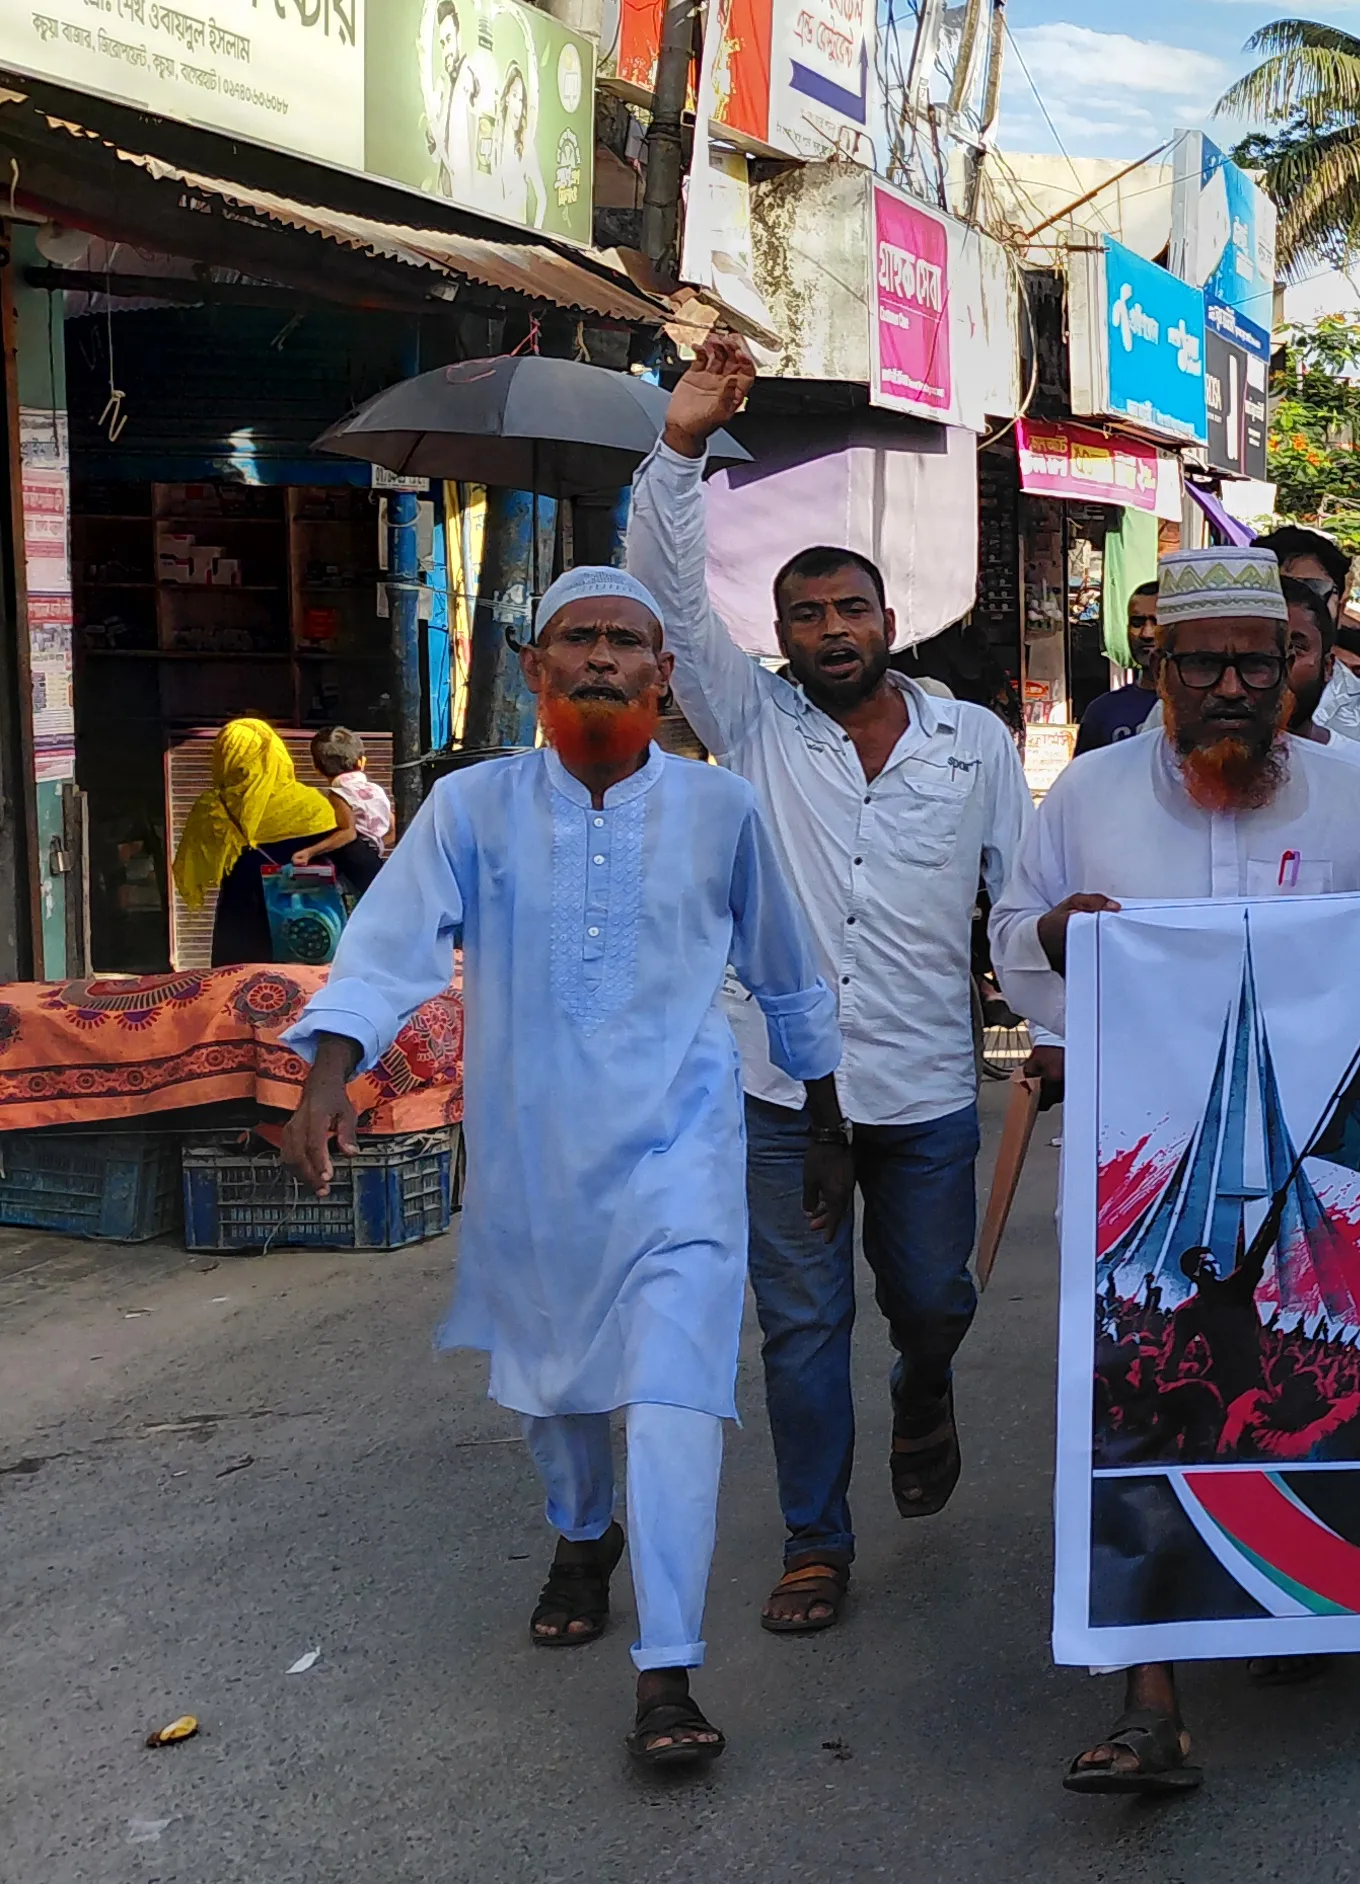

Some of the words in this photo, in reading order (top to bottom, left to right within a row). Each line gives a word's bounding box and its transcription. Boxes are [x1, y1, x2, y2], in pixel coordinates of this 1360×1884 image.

[32, 12, 58, 41] কচুয়া
[62, 22, 95, 53] বাজার,
[152, 53, 178, 81] কচুয়া,
[208, 17, 250, 63] ইসলাম
